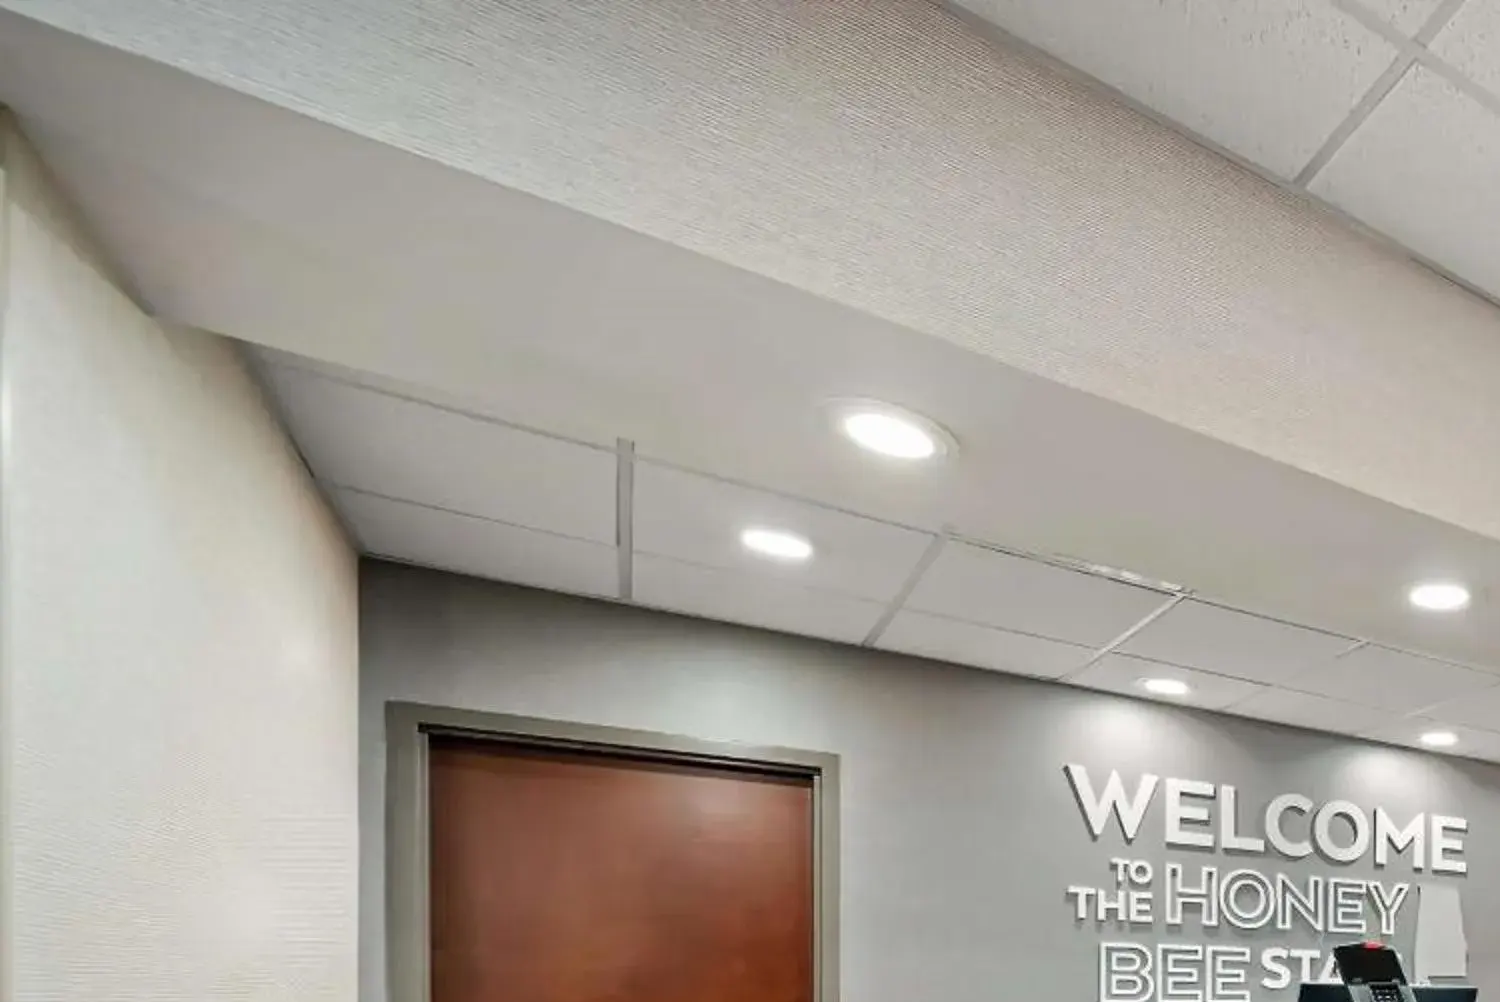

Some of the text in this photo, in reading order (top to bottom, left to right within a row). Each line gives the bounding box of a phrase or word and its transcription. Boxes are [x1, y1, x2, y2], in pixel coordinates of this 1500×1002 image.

[1063, 764, 1468, 872] WELCOME
[1066, 863, 1408, 934] THE HONEY
[1110, 857, 1153, 884] TO
